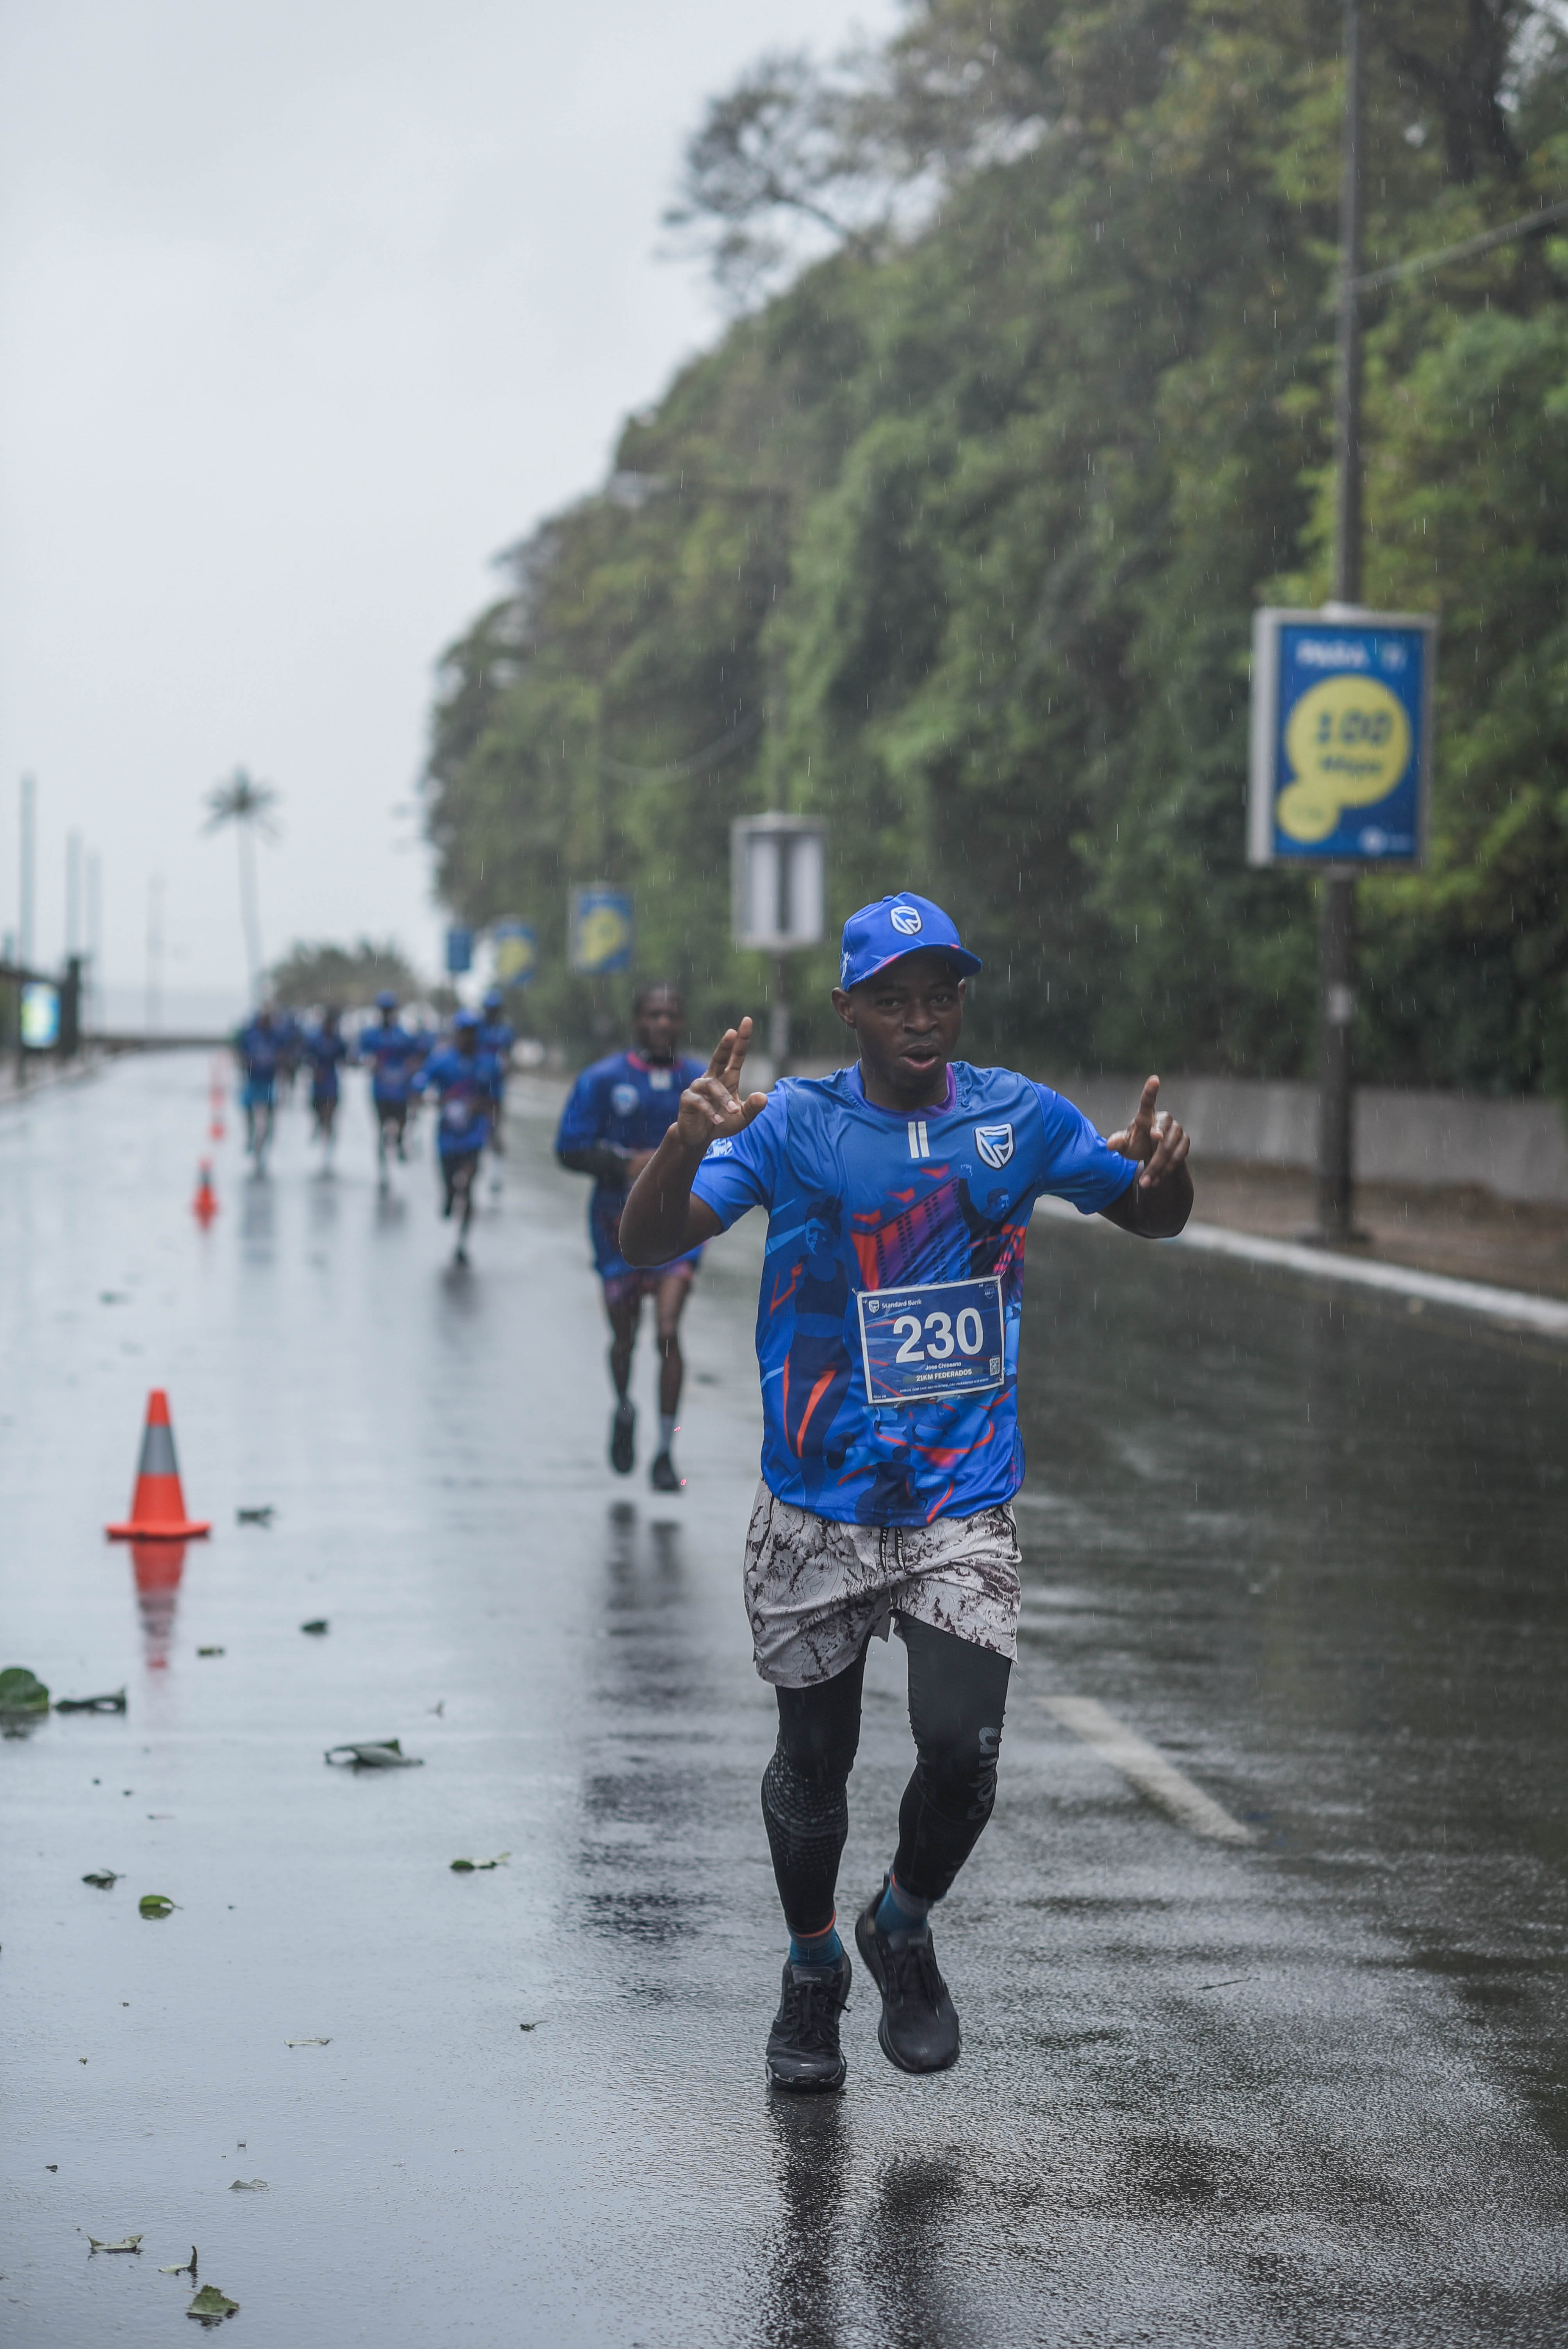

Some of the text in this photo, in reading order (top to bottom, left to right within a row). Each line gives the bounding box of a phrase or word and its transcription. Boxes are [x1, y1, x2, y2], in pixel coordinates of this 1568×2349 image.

[881, 1300, 907, 1309] Standard
[893, 1307, 984, 1363] 230
[916, 1368, 972, 1382] 21KM FEDERADOS
